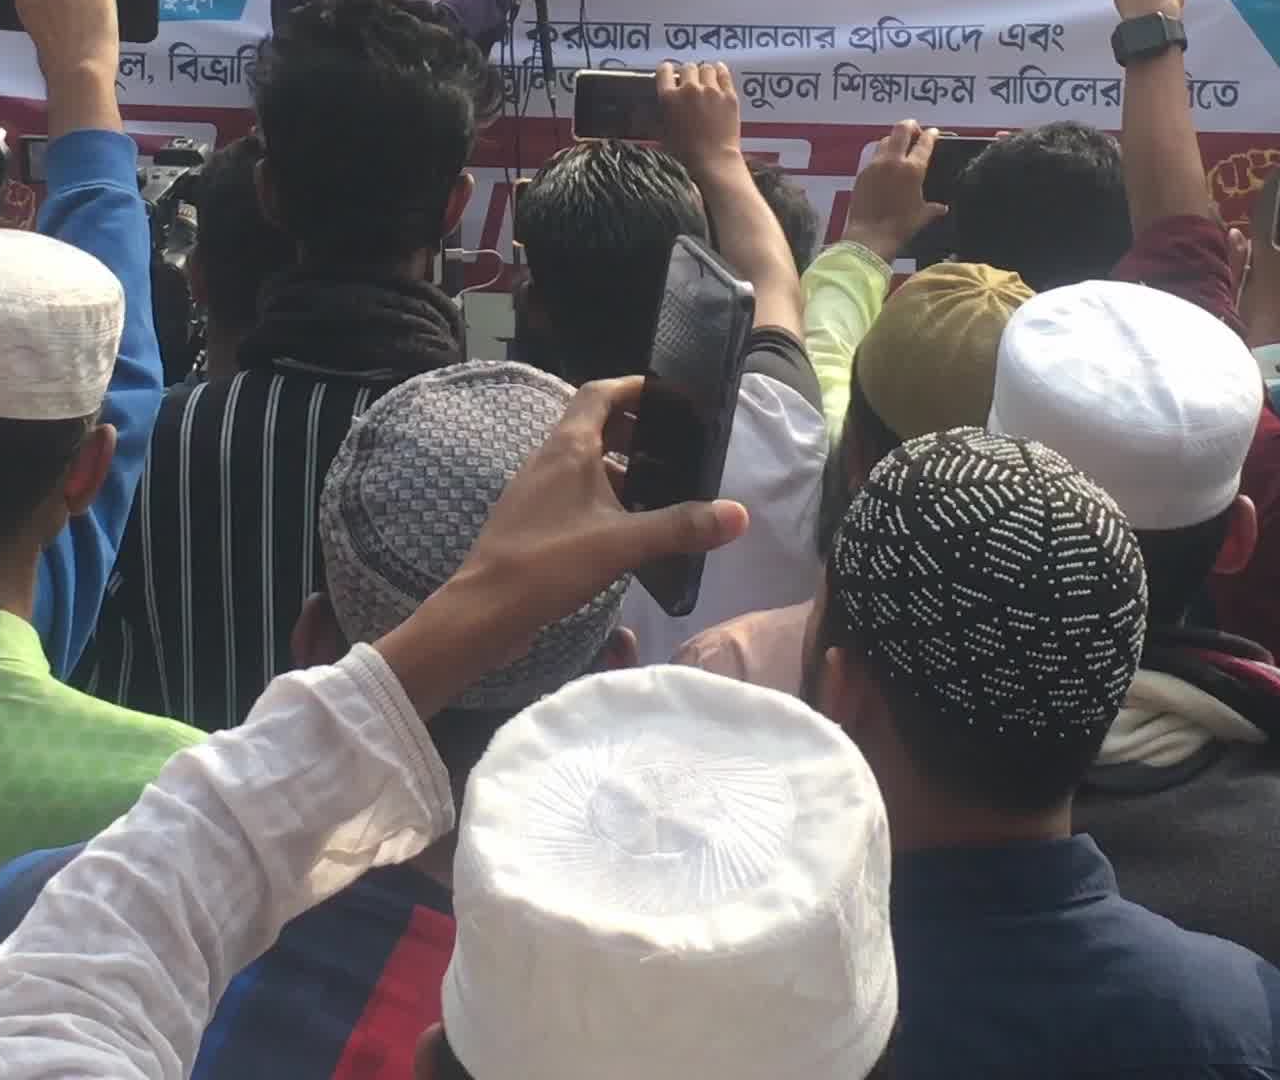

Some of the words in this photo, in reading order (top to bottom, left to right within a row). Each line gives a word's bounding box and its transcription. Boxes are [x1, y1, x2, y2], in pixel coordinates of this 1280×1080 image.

[664, 23, 835, 50] অবমাননার
[849, 16, 984, 53] প্রতিবাদে
[999, 23, 1065, 51] এবং
[741, 71, 822, 110] নুতন
[833, 62, 976, 105] শিক্ষাক্রম
[986, 65, 1121, 107] বাতিলের
